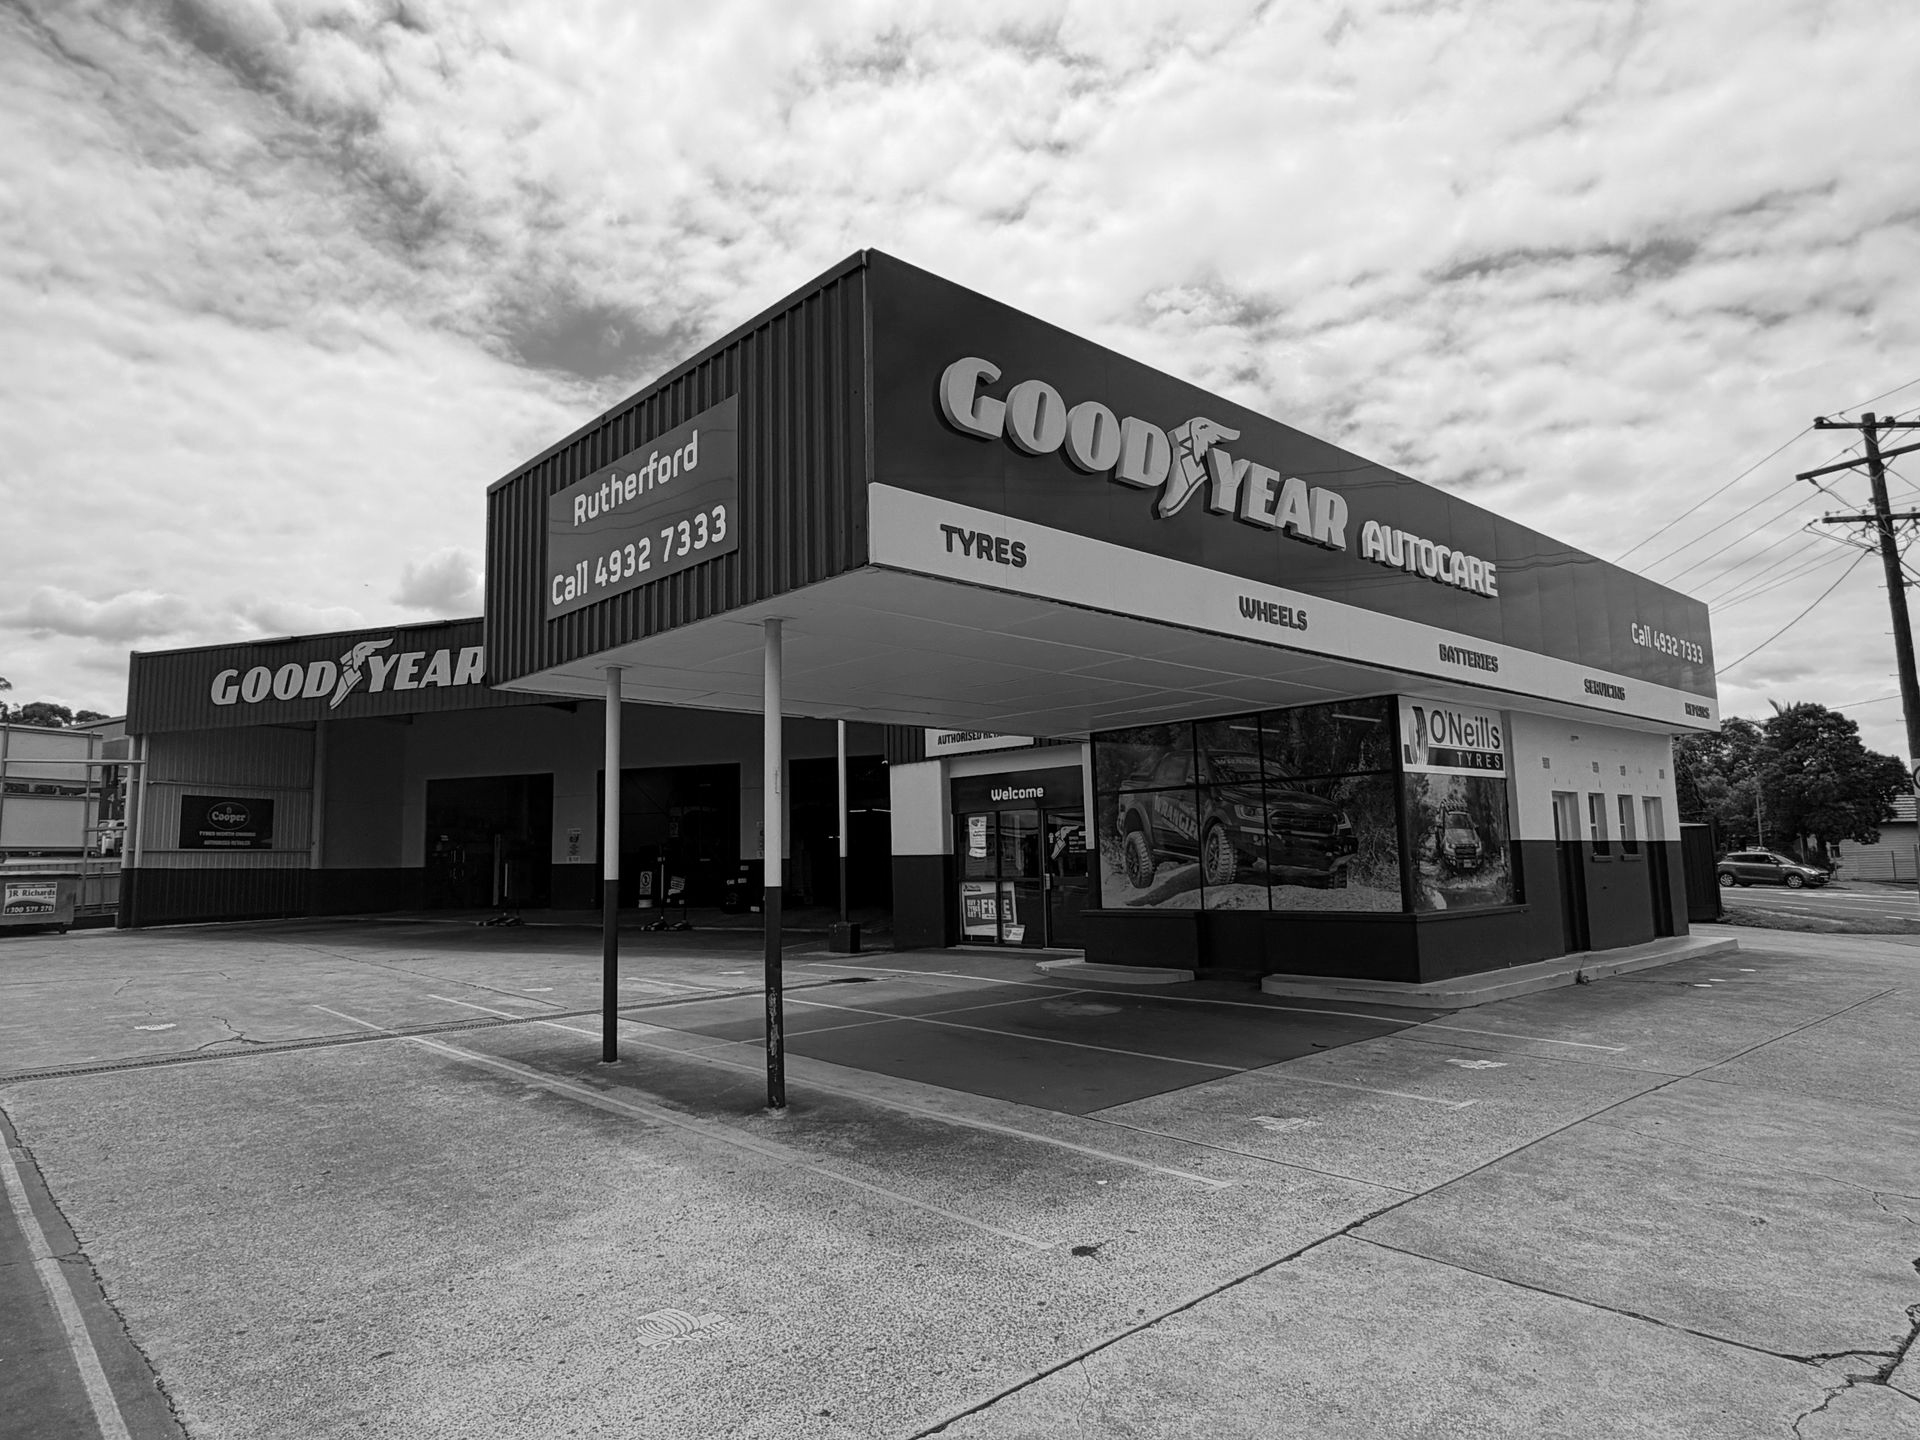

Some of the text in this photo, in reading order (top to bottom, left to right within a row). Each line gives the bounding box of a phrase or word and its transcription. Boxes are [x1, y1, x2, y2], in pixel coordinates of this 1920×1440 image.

[574, 430, 698, 527] Rutherford
[940, 357, 1498, 598] GOODYEAR AUTOCARE
[552, 504, 726, 605] Call 4932 7333
[940, 524, 1027, 568] TYRES
[1239, 595, 1307, 631] WHEELS
[1439, 644, 1498, 672] BATTERIES
[1632, 622, 1703, 664] Call 4932 7333
[210, 645, 485, 706] GOODYEAR
[1584, 678, 1625, 701] SERVICING
[937, 732, 982, 745] AUTHORISED
[1430, 710, 1501, 749] O'Neills
[1457, 752, 1500, 768] TYRES
[991, 786, 1044, 801] Welcome
[210, 811, 247, 824] Cooper
[1154, 794, 1199, 841] WRANGLE
[8, 889, 55, 899] JR Richards
[981, 899, 1011, 914] FRE
